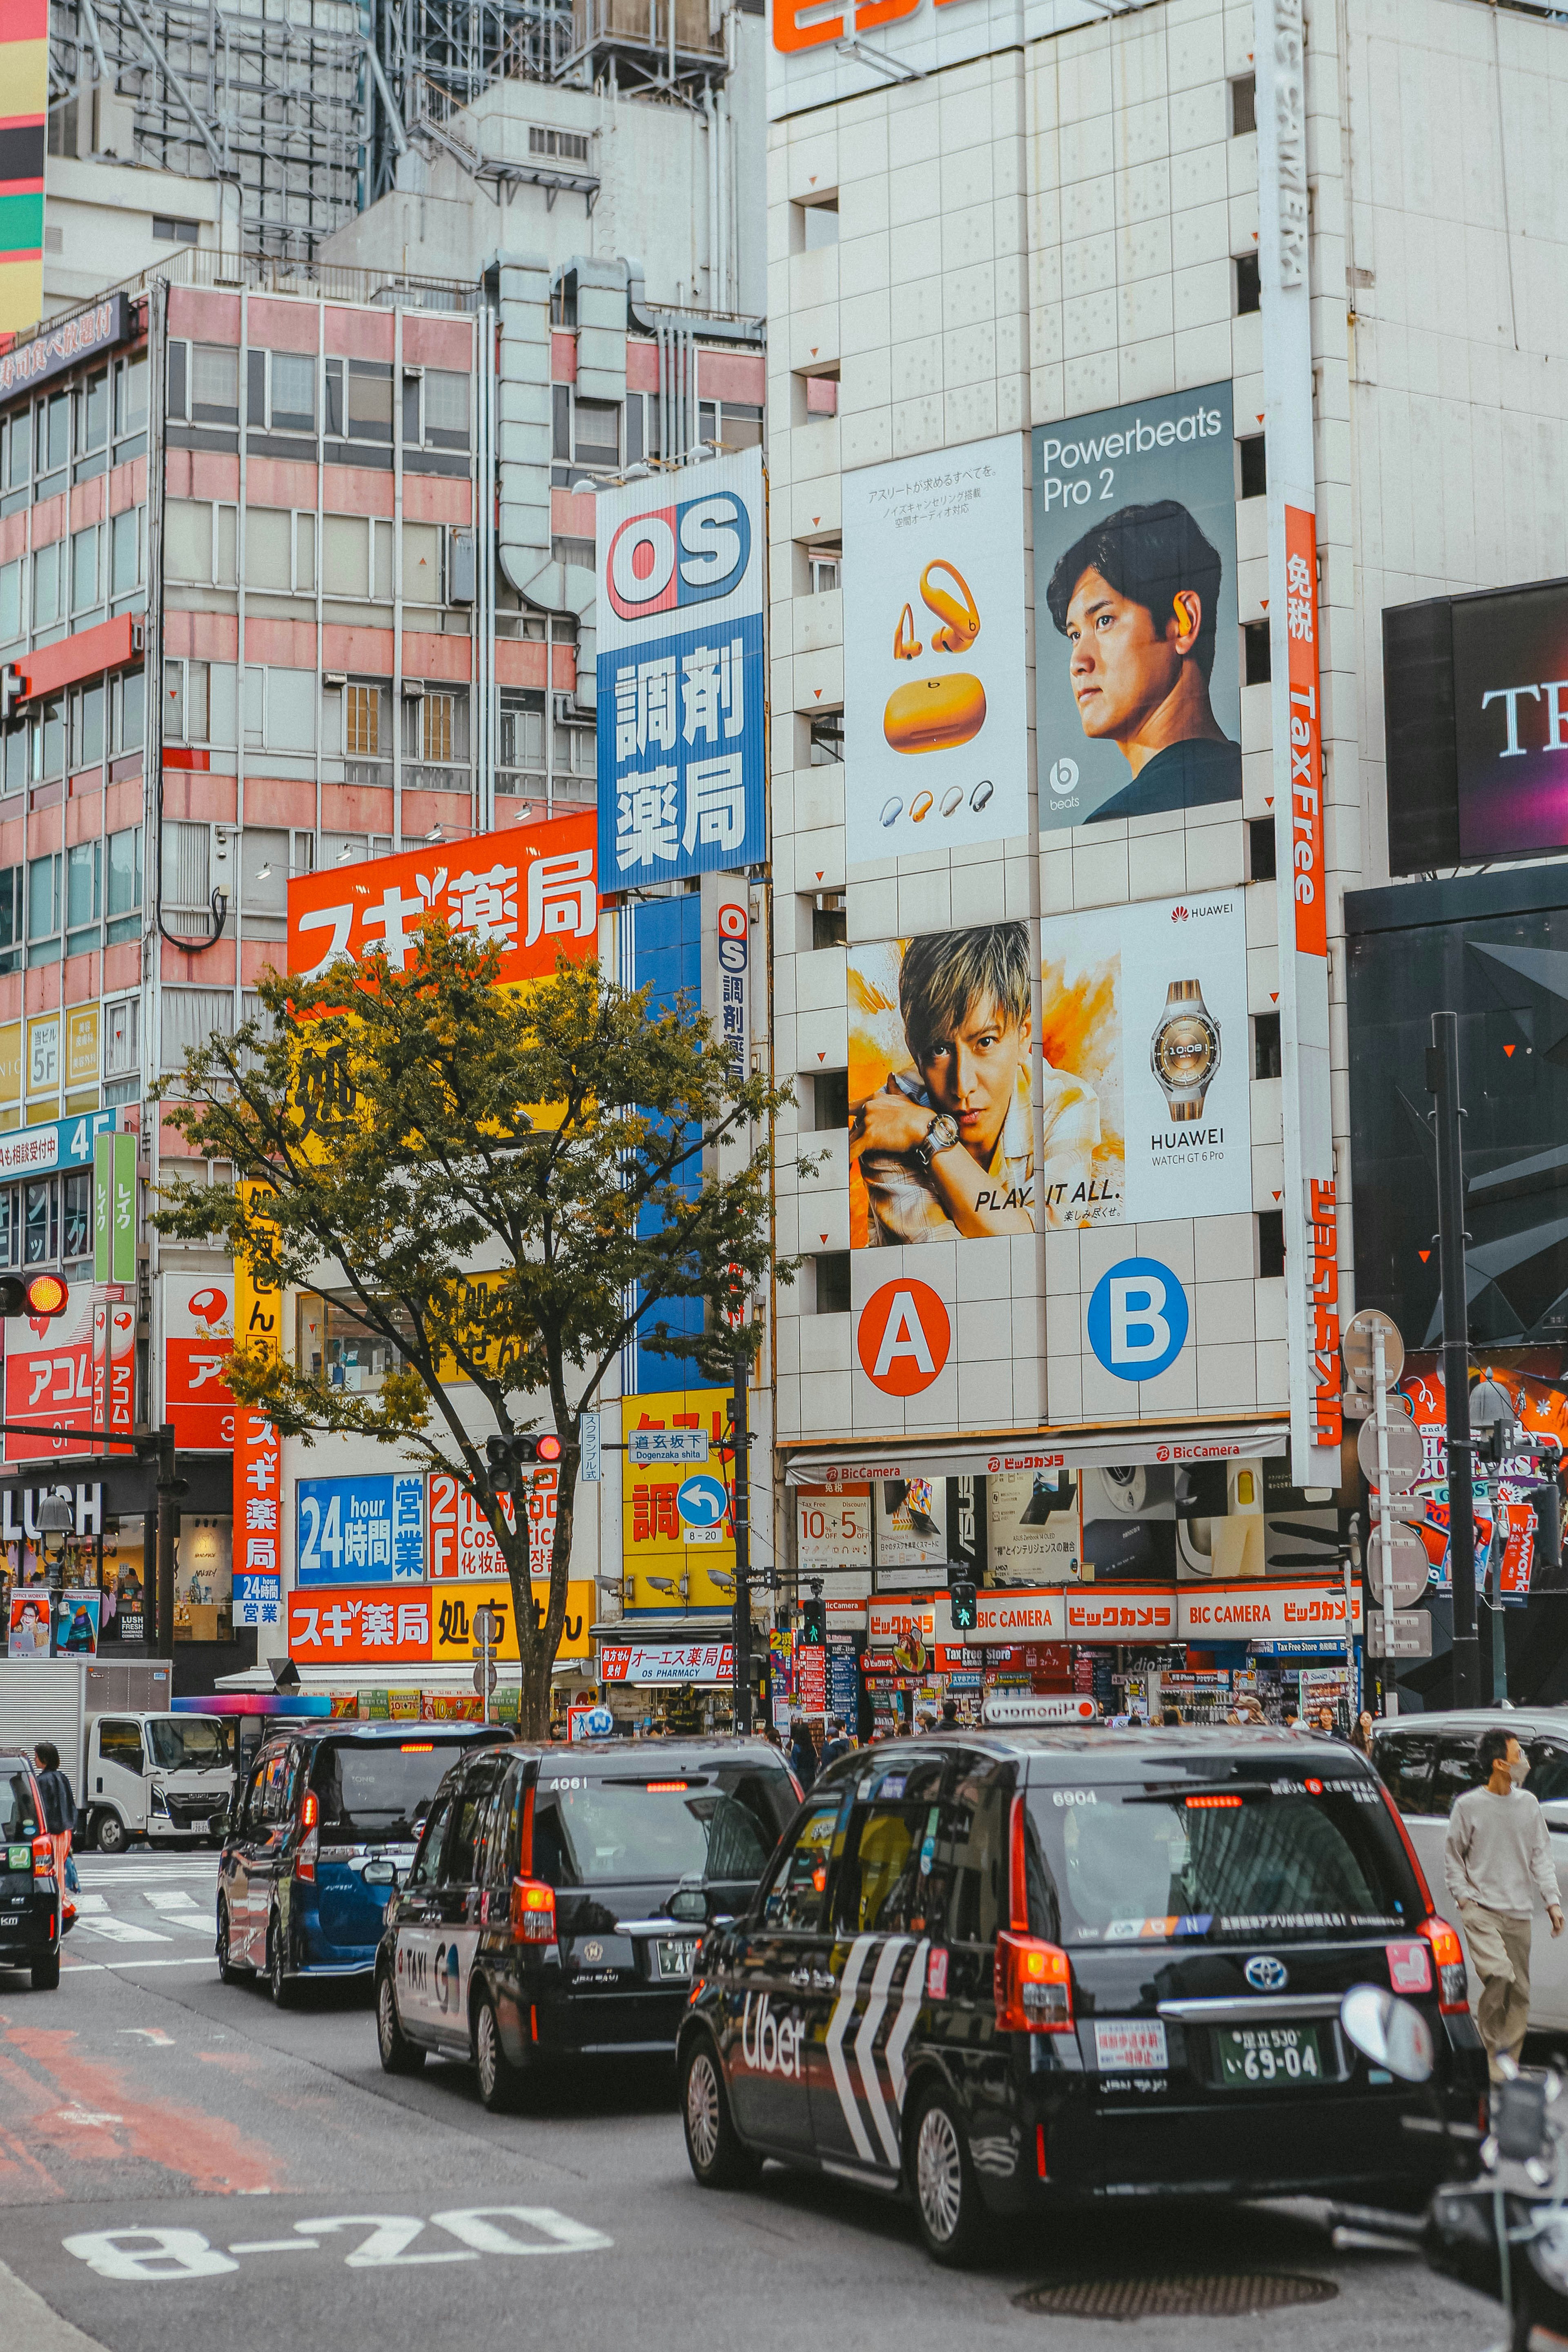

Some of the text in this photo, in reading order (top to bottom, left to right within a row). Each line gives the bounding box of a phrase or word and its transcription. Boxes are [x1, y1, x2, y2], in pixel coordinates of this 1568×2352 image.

[1043, 406, 1222, 474] Powerbeats
[869, 465, 996, 503] アスリートが求めるすべてを。
[1043, 469, 1114, 512] Pro 2
[883, 488, 981, 519] ノイズキャンセリング搭載
[895, 503, 969, 529] 空間オーディオ対応
[613, 499, 740, 603] OS
[1287, 553, 1313, 644] 免税
[615, 638, 744, 762] 調剤
[616, 752, 745, 872] 薬局
[1049, 795, 1080, 811] beats
[298, 849, 597, 984] スギ薬局
[1191, 903, 1234, 919] HUAWEI
[721, 909, 745, 969] OS
[35, 1029, 56, 1046] 当ビル
[33, 1048, 56, 1083] 5F
[1151, 1127, 1224, 1150] HUAWEI
[1152, 1151, 1224, 1166] WATCH GT 6 Pro
[97, 1183, 106, 1231] レイク
[117, 1183, 131, 1229] レイク
[974, 1179, 1120, 1212] PLAY IT ALL.
[1064, 1207, 1120, 1222] 楽しみ尽くせ。
[1109, 1275, 1170, 1364] B
[872, 1290, 936, 1377] A
[94, 1366, 104, 1424] アコム
[112, 1366, 131, 1424] アコム
[585, 1416, 596, 1480] スクランブル式
[635, 1434, 702, 1450] 道玄坂下
[636, 1450, 679, 1460] Dogenzaka
[1174, 1444, 1240, 1459] BicCamera
[841, 1467, 900, 1479] BicCamera
[1004, 1454, 1065, 1470] ビックカメラ
[246, 1416, 278, 1570] スギ薬局
[825, 1484, 843, 1492] 免税
[300, 1494, 385, 1570] 24 hour
[395, 1478, 423, 1577] 営業
[432, 1476, 457, 1576] 2F
[801, 1511, 856, 1539] 10 5
[344, 1519, 390, 1567] 時間
[243, 1576, 260, 1600] 24
[261, 1585, 278, 1600] 時間
[243, 1603, 277, 1623] 営業
[291, 1600, 430, 1647] スギ薬局
[1000, 1609, 1052, 1627] CAMERA
[1069, 1607, 1171, 1626] ビックカメラ
[1190, 1605, 1271, 1624] BIC CAMERA
[1284, 1599, 1360, 1622] ビックカメラ
[871, 1615, 933, 1635] ビックカメラ
[603, 1650, 629, 1662] 処方せん
[631, 1648, 718, 1667] オーエス薬局
[945, 1648, 1011, 1660] Tax Free Store
[1046, 1648, 1052, 1657] A
[1277, 1642, 1317, 1651] Tax Free Store
[607, 1664, 621, 1677] 受付
[656, 1669, 700, 1677] PHARMACY
[1180, 1673, 1195, 1681] iPhone
[1051, 1789, 1097, 1807] 6904
[407, 1949, 427, 1992] TAXI
[742, 1991, 806, 2079] Uber
[1245, 2045, 1318, 2080] 69-04
